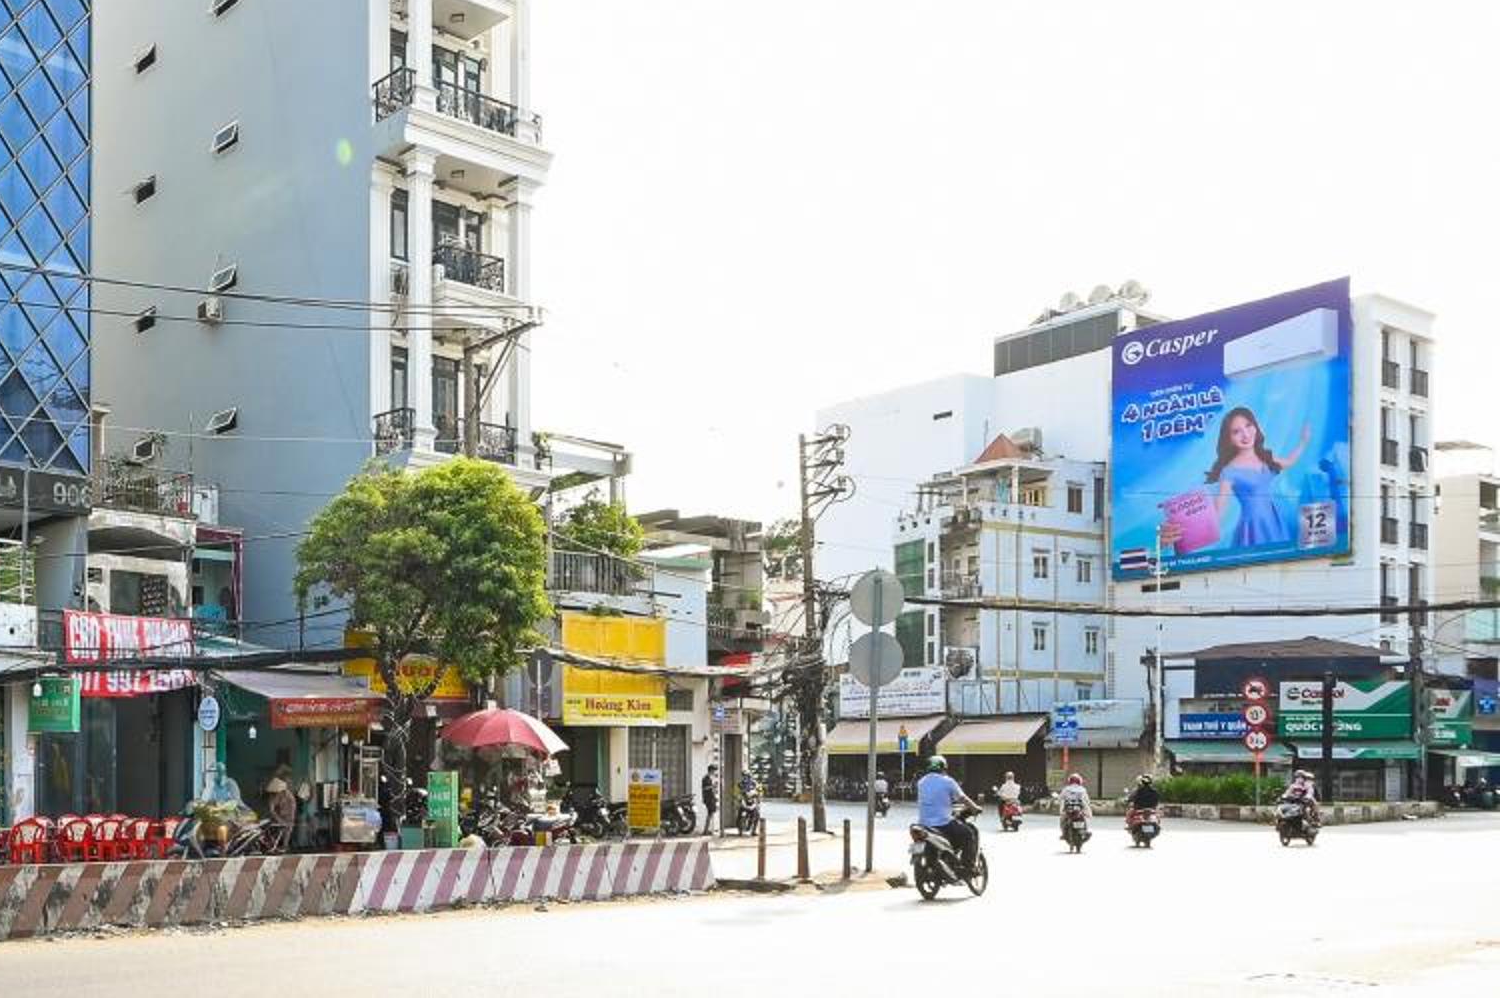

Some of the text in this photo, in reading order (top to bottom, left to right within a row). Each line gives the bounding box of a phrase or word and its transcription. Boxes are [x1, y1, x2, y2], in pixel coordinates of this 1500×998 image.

[1145, 329, 1219, 357] Casper
[1122, 403, 1140, 423] 4
[1143, 419, 1155, 442] 1
[53, 482, 92, 509] 906
[1305, 512, 1327, 529] 12
[626, 698, 651, 711] Kim
